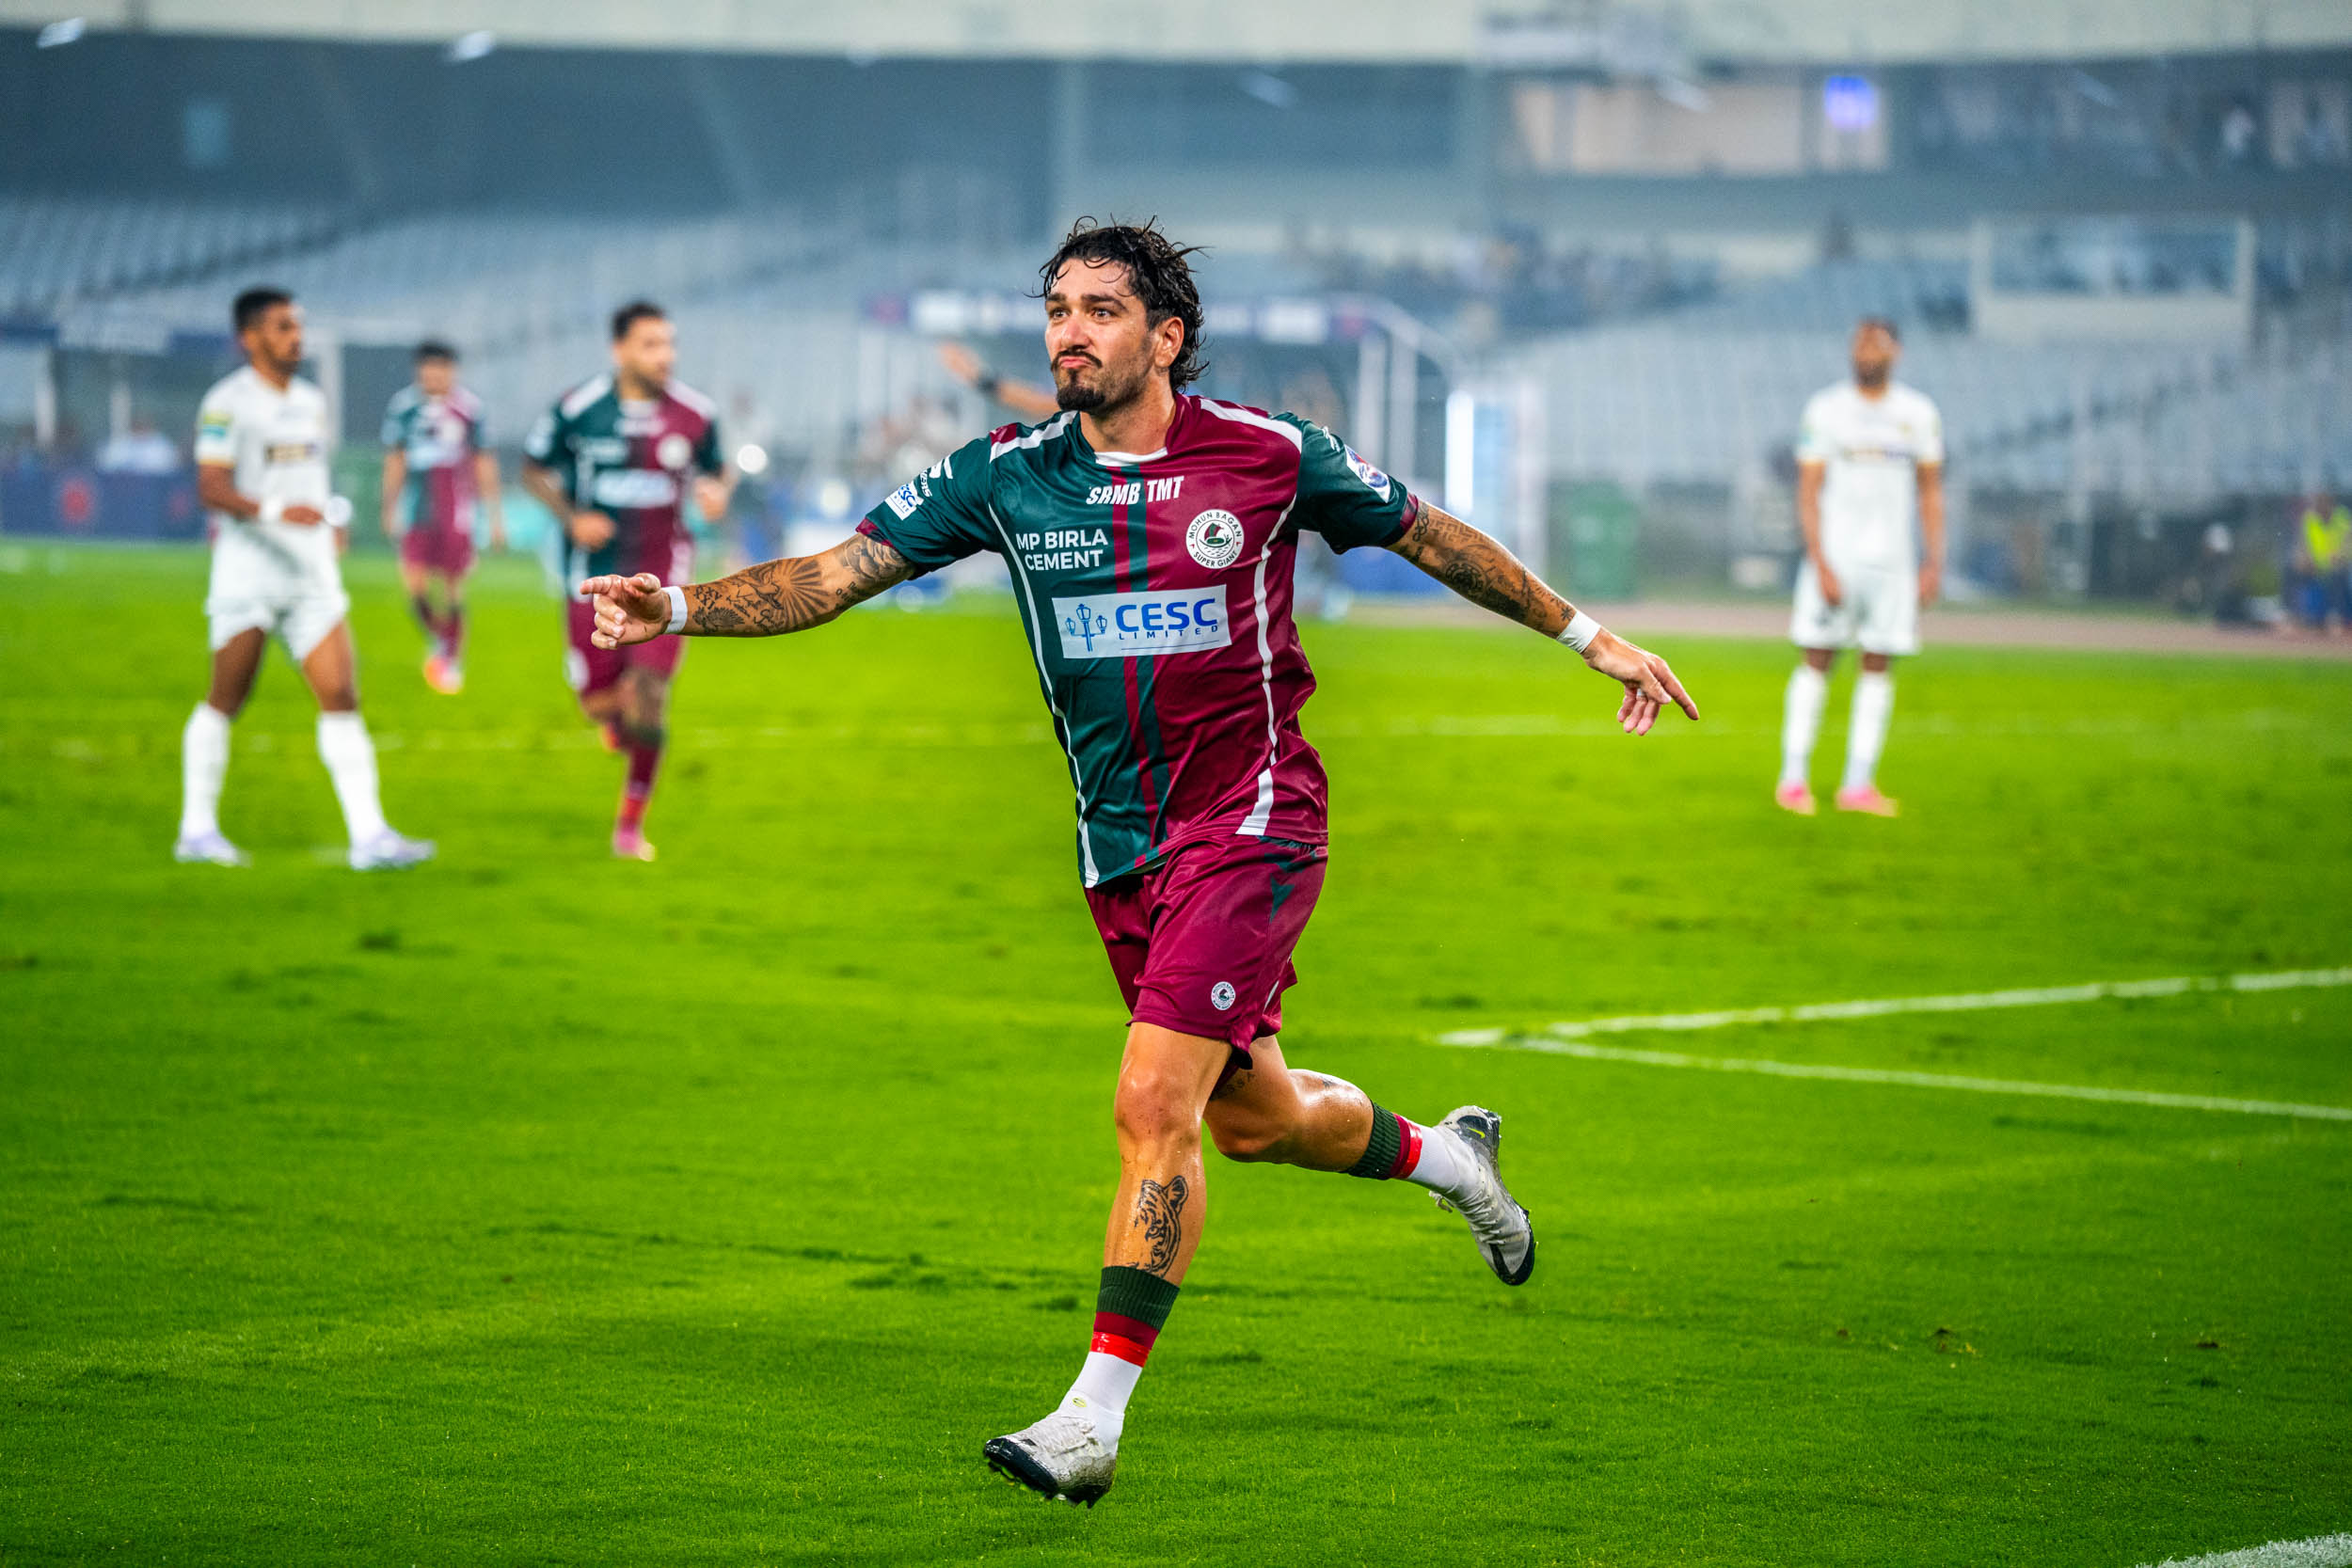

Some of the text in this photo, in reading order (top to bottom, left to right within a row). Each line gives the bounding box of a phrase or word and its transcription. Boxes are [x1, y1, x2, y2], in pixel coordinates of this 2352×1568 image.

[1085, 475, 1185, 505] SRMB TMT
[1188, 512, 1242, 539] MOHUN BAGAN
[1015, 528, 1109, 550] MP BIRLA
[1024, 549, 1104, 571] CEMENT
[1193, 550, 1238, 567] SUPER GIANT
[1115, 598, 1218, 633] CESC
[1118, 626, 1219, 641] LIMITED
